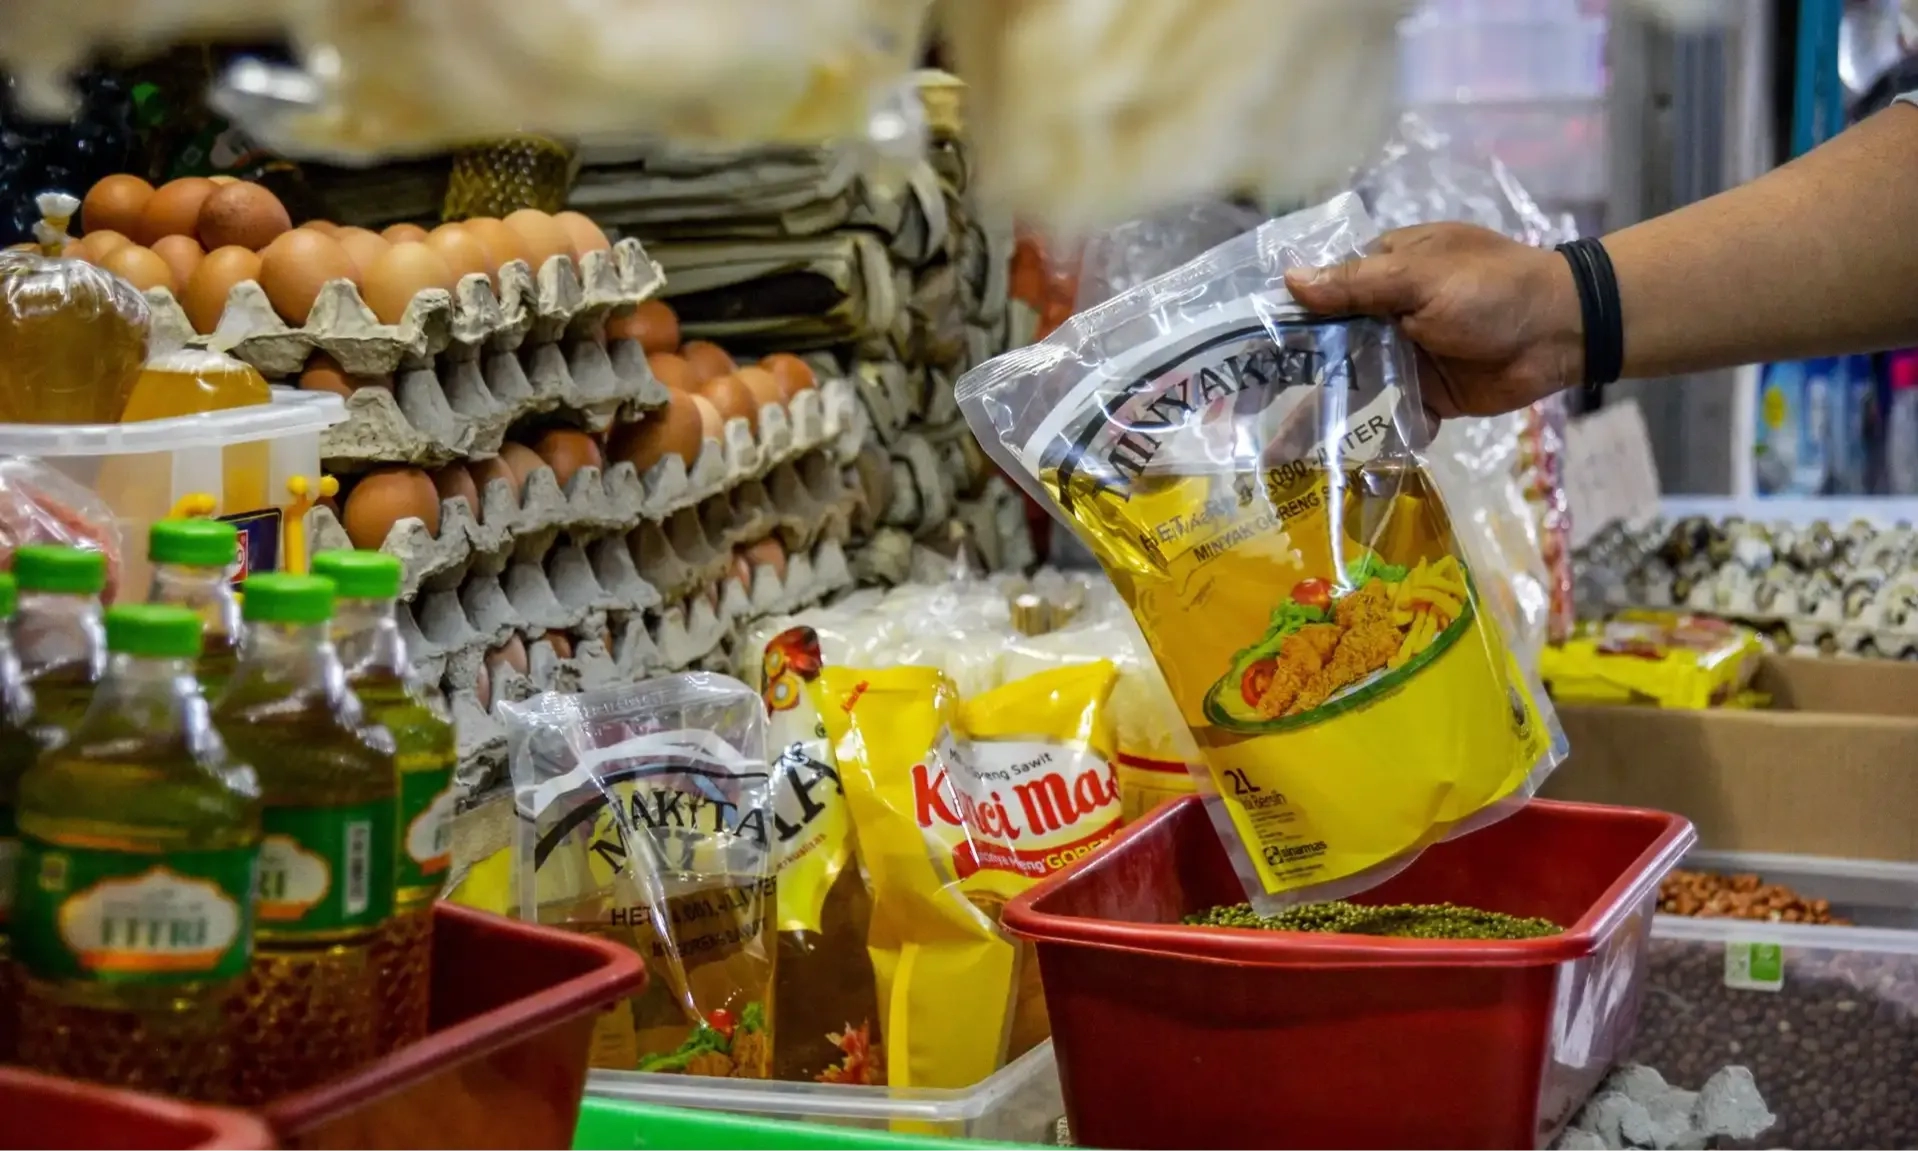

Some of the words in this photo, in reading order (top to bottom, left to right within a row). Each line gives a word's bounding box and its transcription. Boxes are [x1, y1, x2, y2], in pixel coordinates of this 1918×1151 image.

[1193, 525, 1256, 562] MINYAK
[1011, 751, 1053, 775] Sawit
[1223, 767, 1262, 795] 2L
